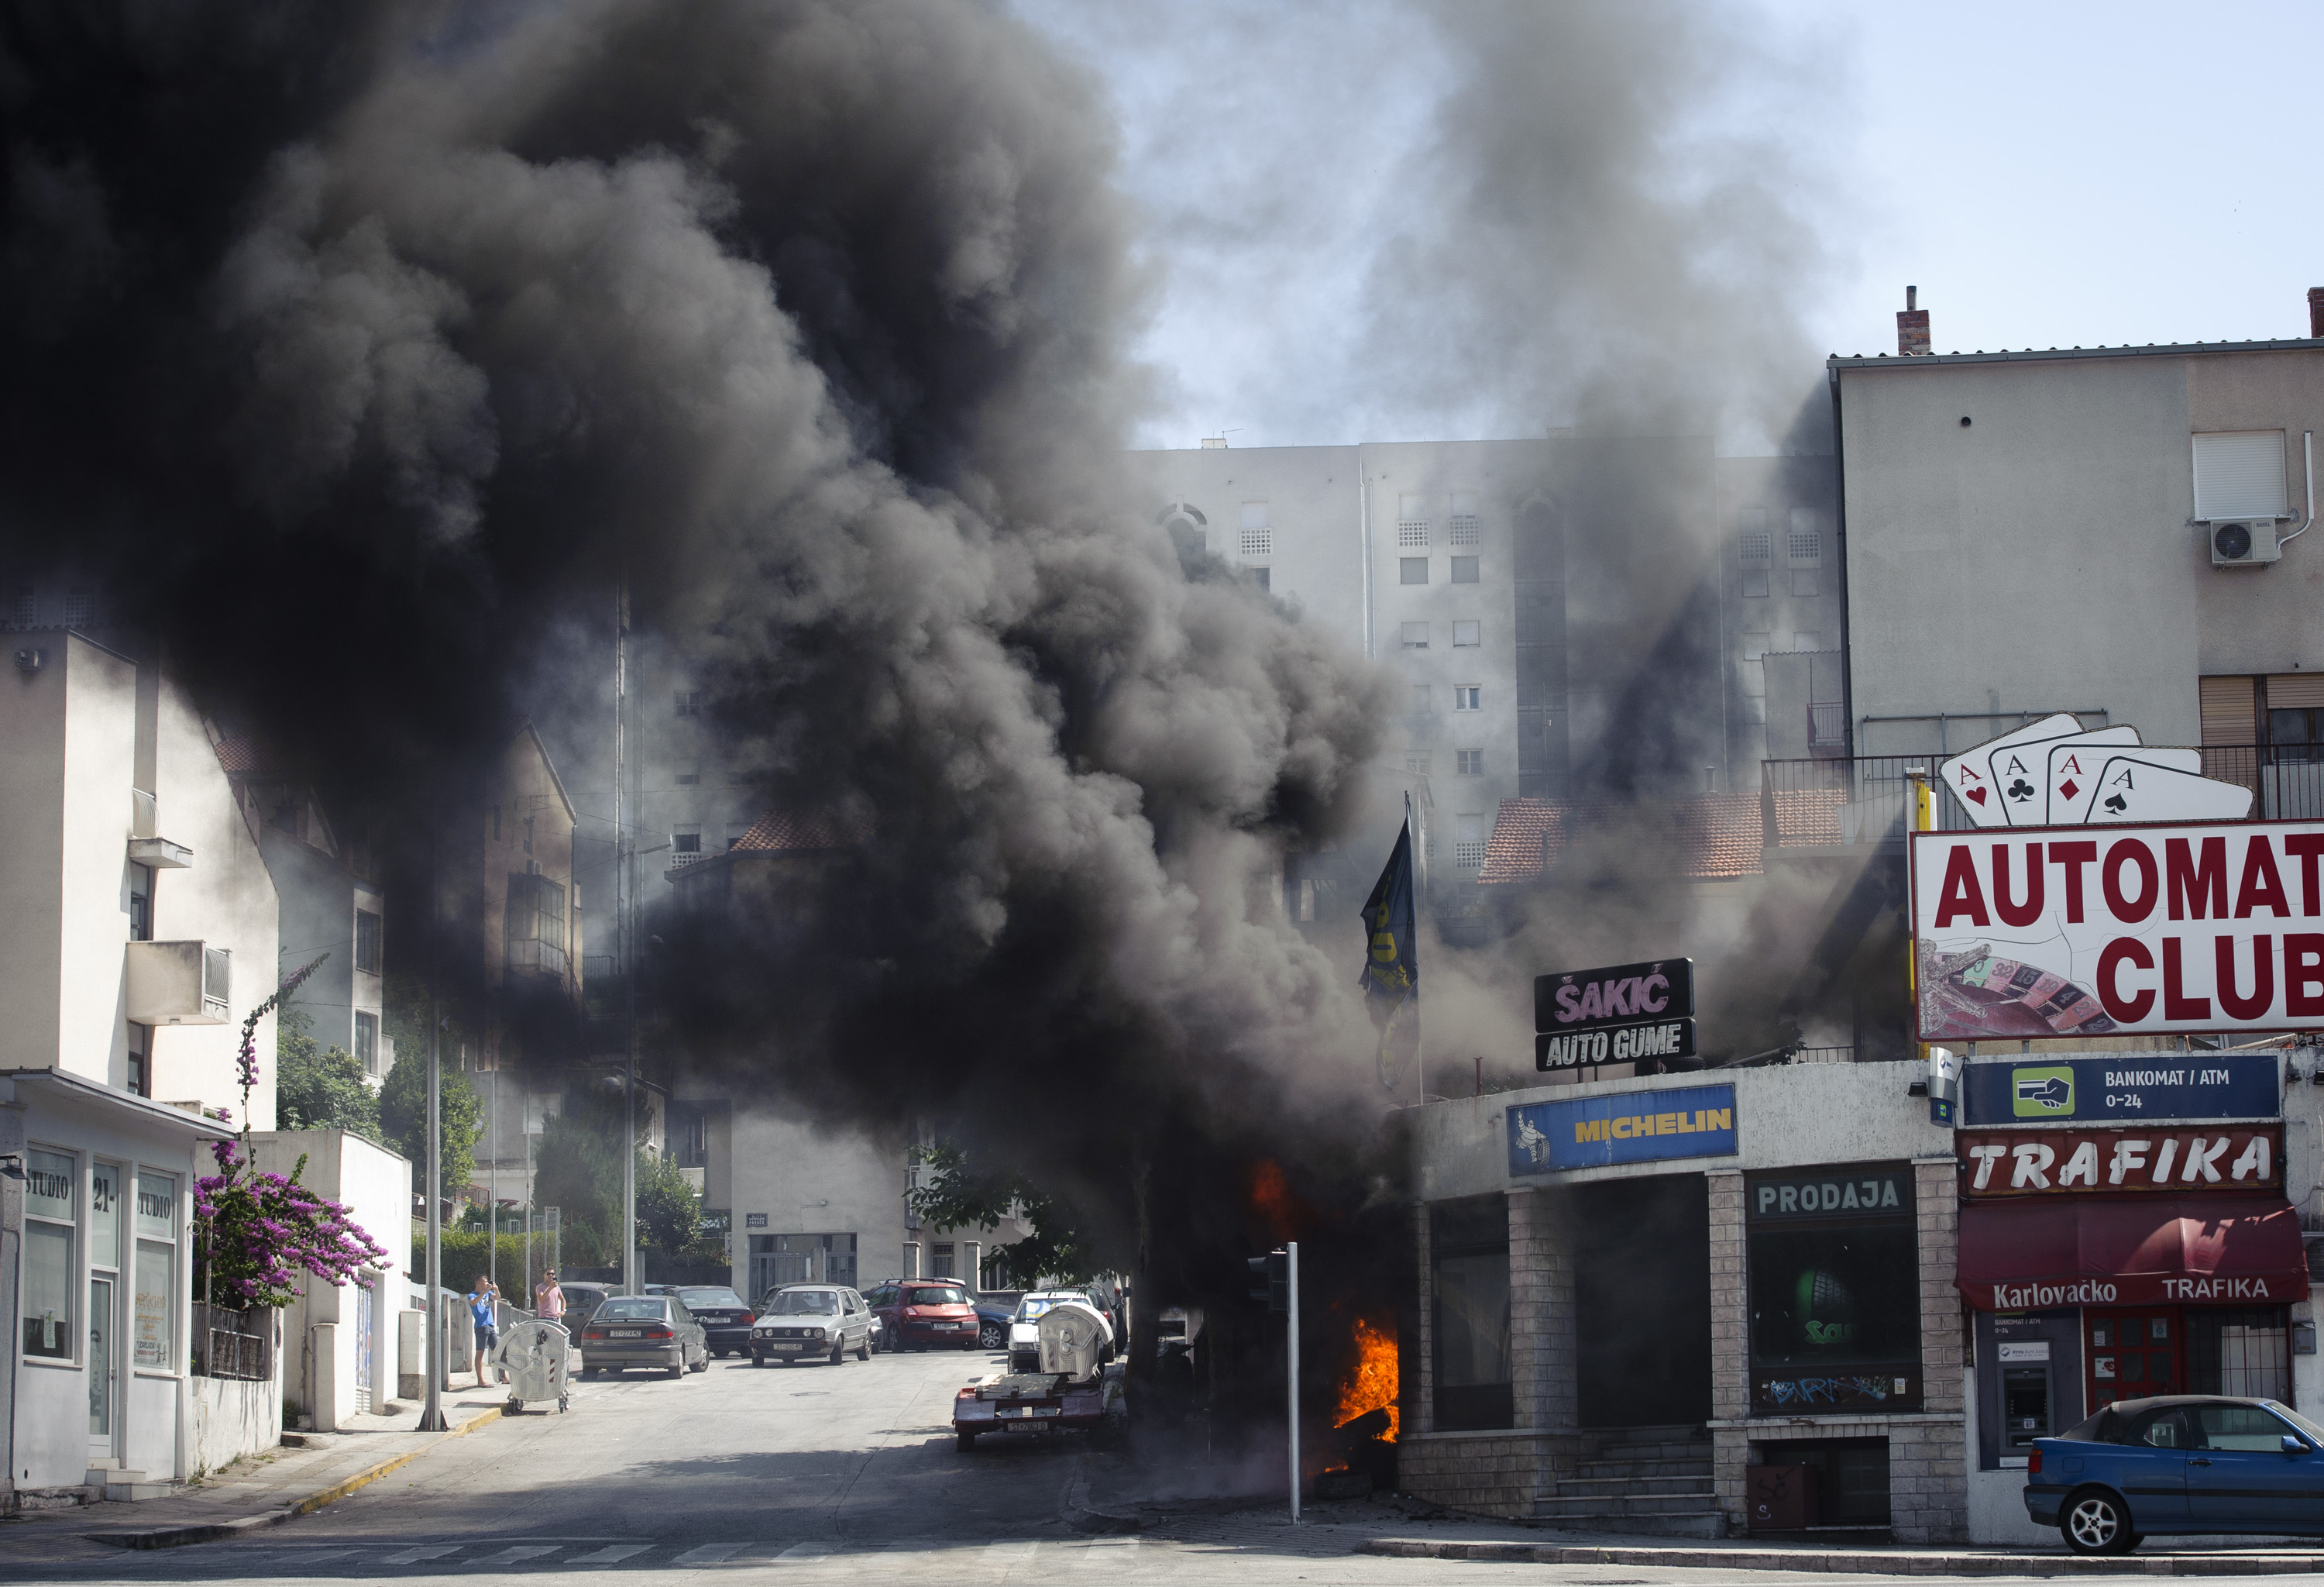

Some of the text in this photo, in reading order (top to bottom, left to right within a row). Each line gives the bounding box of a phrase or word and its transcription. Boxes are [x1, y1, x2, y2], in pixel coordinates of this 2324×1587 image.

[1959, 763, 1983, 786] A
[2005, 754, 2030, 776] A
[2058, 754, 2085, 775] A
[2110, 768, 2135, 790] A
[1934, 834, 2324, 928] AUTOMAT
[1554, 963, 1669, 1023] ŠAKIĆ
[1992, 962, 2015, 979] 32
[2016, 969, 2039, 984] 15
[2037, 978, 2060, 993] 19
[2059, 991, 2077, 1004] 4
[2073, 1000, 2097, 1019] 21
[2096, 933, 2324, 1024] CLUB
[1546, 1024, 1681, 1066] AUTO GUME
[2106, 1070, 2185, 1086] BANKOMAT
[2199, 1069, 2229, 1085] ATM
[2106, 1094, 2143, 1108] 0-24
[1575, 1108, 1731, 1143] MICHELIN
[1969, 1136, 2271, 1189] TRAFIKA
[26, 1169, 68, 1200] STUDIO
[138, 1192, 170, 1219] TUDIO
[1758, 1180, 1899, 1213] PRODAJA
[1993, 1278, 2269, 1309] Karlovačko TRAFIKA
